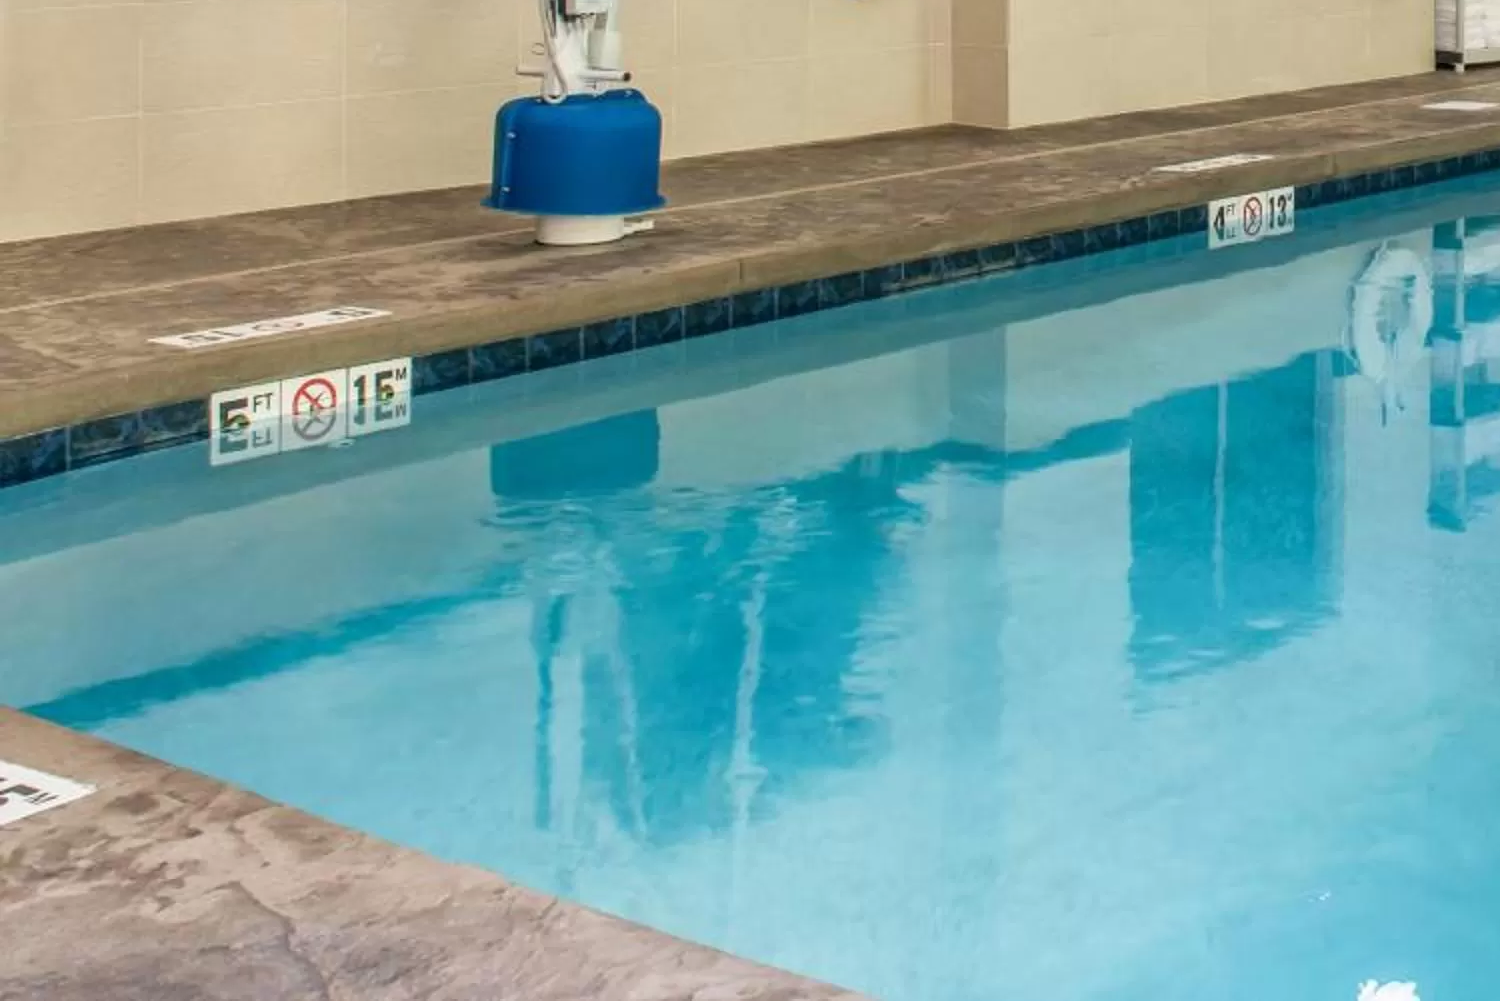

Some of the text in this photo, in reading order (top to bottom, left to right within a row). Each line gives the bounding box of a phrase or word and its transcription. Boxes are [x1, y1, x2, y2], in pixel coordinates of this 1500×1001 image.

[395, 366, 408, 381] M
[219, 392, 273, 439] 5 FT
